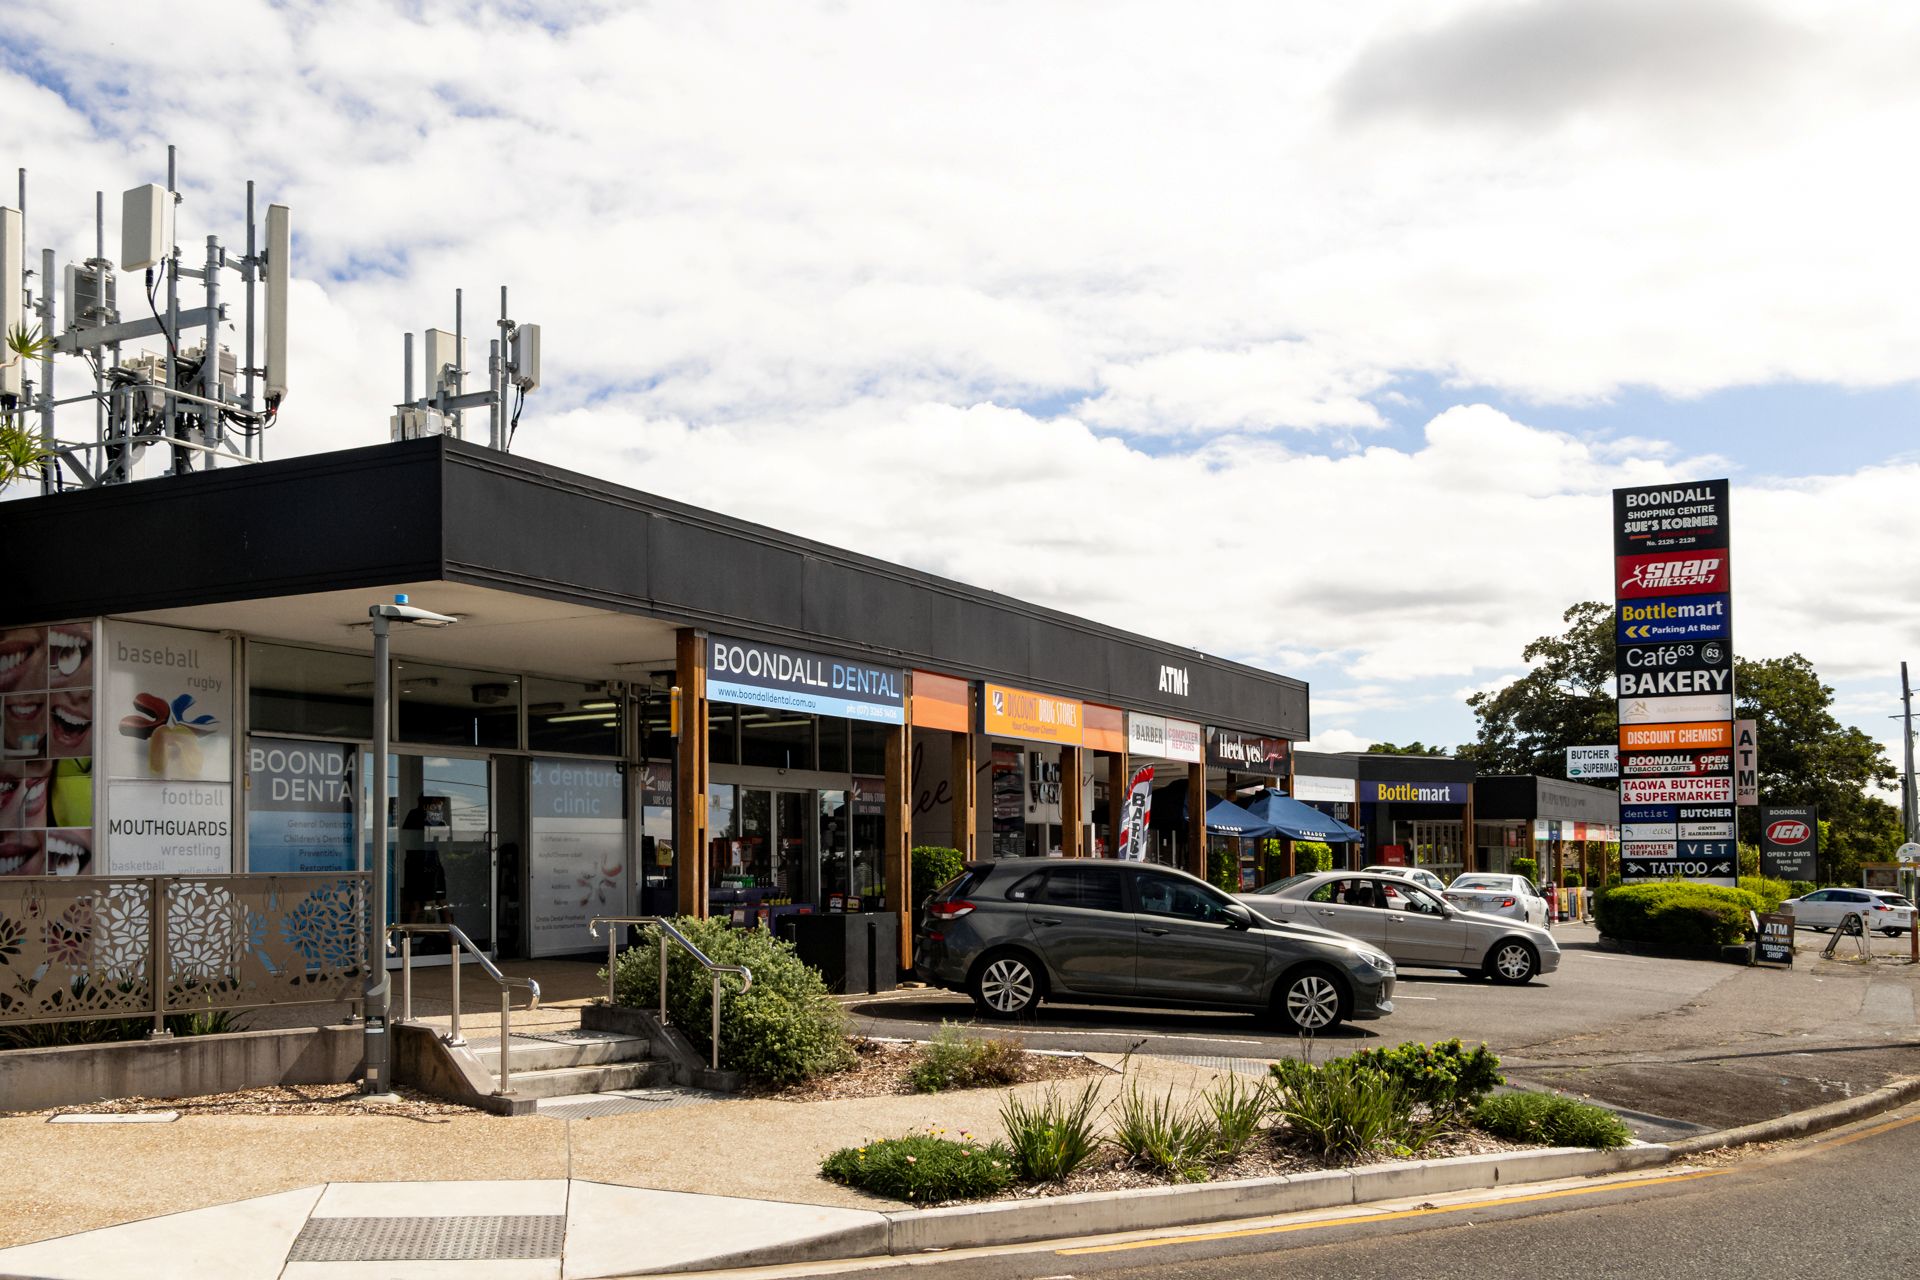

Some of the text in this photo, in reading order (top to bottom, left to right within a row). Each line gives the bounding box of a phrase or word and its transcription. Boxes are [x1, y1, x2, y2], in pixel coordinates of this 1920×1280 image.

[1626, 487, 1715, 508] BOONDALL
[1627, 504, 1715, 520] SHOPPING CENTRE
[1624, 515, 1718, 533] SUE'S KORNER
[1622, 601, 1723, 621] Bottlemart
[1652, 626, 1686, 635] Parking
[118, 641, 199, 669] baseball
[1706, 648, 1719, 658] 63
[714, 643, 899, 698] BOONDALL DENTAL
[186, 676, 222, 692] rugby
[1159, 665, 1183, 695] ATM
[1620, 669, 1729, 695] BAKERY
[718, 687, 816, 708] www.boondalldental.com.au
[1007, 694, 1077, 728] DISCOUNT DRUG STORES
[1135, 724, 1164, 744] BARBER
[1168, 728, 1198, 741] COMPUTER
[1627, 728, 1724, 745] DISCOUNT CHEMIST
[1171, 740, 1195, 752] REPAIRS
[1219, 733, 1264, 769] Heck yes!
[1571, 749, 1610, 760] BUTCHER
[1628, 755, 1693, 766] BOONDALL
[1700, 755, 1729, 764] OPEN
[1738, 729, 1755, 787] ATM
[532, 761, 622, 788] & denture
[1583, 762, 1618, 774] SUPERMAR
[1628, 765, 1662, 773] TOBACCO
[1707, 763, 1729, 771] DAYS
[1623, 778, 1730, 790] TAQWA BUTCHER
[1738, 788, 1756, 796] 24/7
[161, 787, 224, 806] football
[1378, 783, 1450, 802] Bottlemart
[1623, 791, 1729, 802] & SUPERMARKET
[553, 790, 600, 815] clinic
[1624, 810, 1669, 818] dentist
[1680, 808, 1732, 818] BUTCHER
[109, 819, 228, 836] MOUTHGUARDS
[1128, 792, 1145, 861] BARB
[1771, 824, 1806, 839] IGA
[160, 843, 221, 859] wrestling
[1623, 843, 1674, 851] COMPUTER
[111, 860, 165, 871] basketball
[1649, 862, 1708, 875] TATTOO
[1764, 923, 1788, 935] ATM
[1762, 944, 1788, 953] TOBACCO
